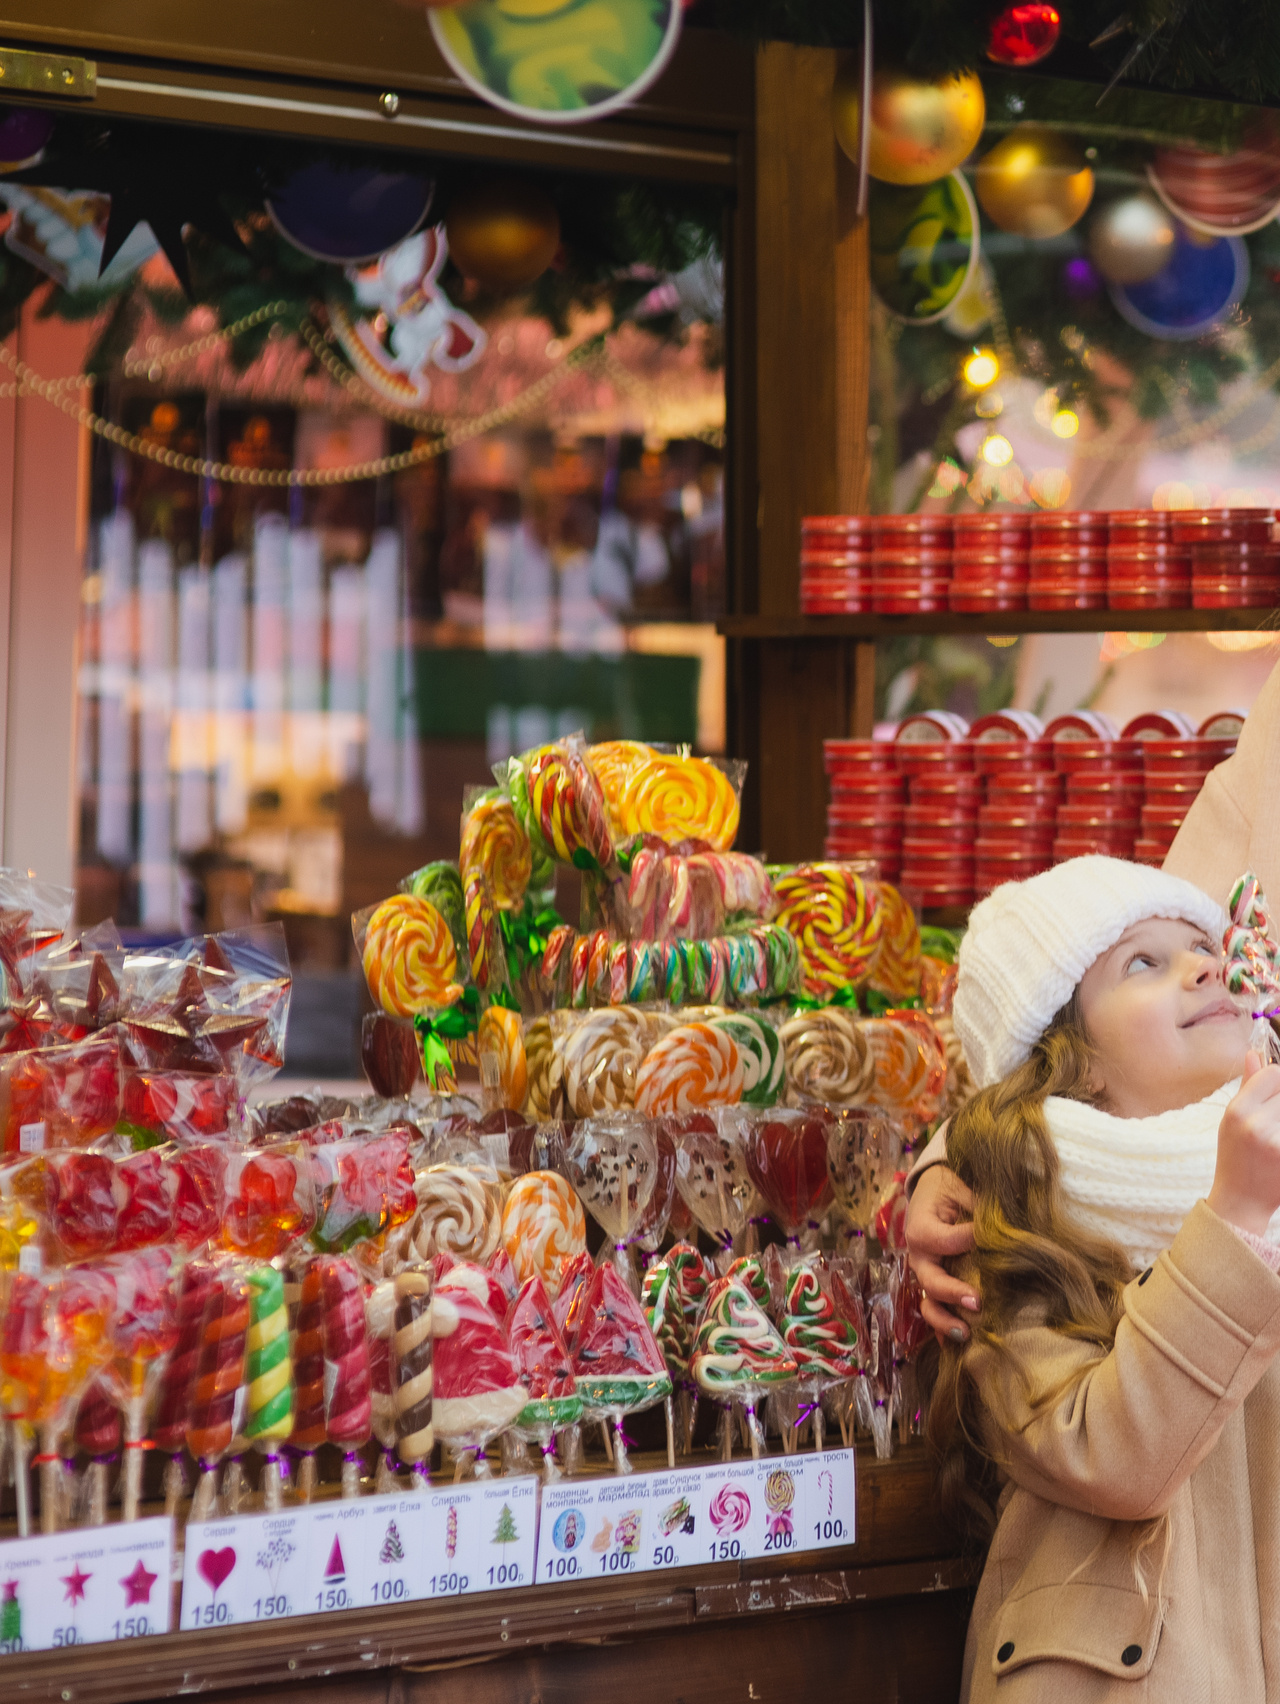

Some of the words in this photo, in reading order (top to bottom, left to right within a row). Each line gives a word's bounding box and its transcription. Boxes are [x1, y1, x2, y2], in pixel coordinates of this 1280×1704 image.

[823, 1452, 849, 1463] трость
[727, 1467, 754, 1479] большой
[669, 1474, 701, 1486] Сундучок
[682, 1483, 701, 1492] какао
[550, 1488, 589, 1500] леденцы
[598, 1489, 649, 1502] мармелад
[431, 1494, 471, 1507] Спираль
[337, 1507, 365, 1520] Арбуз
[262, 1518, 296, 1530] Сердце
[203, 1526, 236, 1538] Сердце
[429, 1572, 469, 1594] 150р
